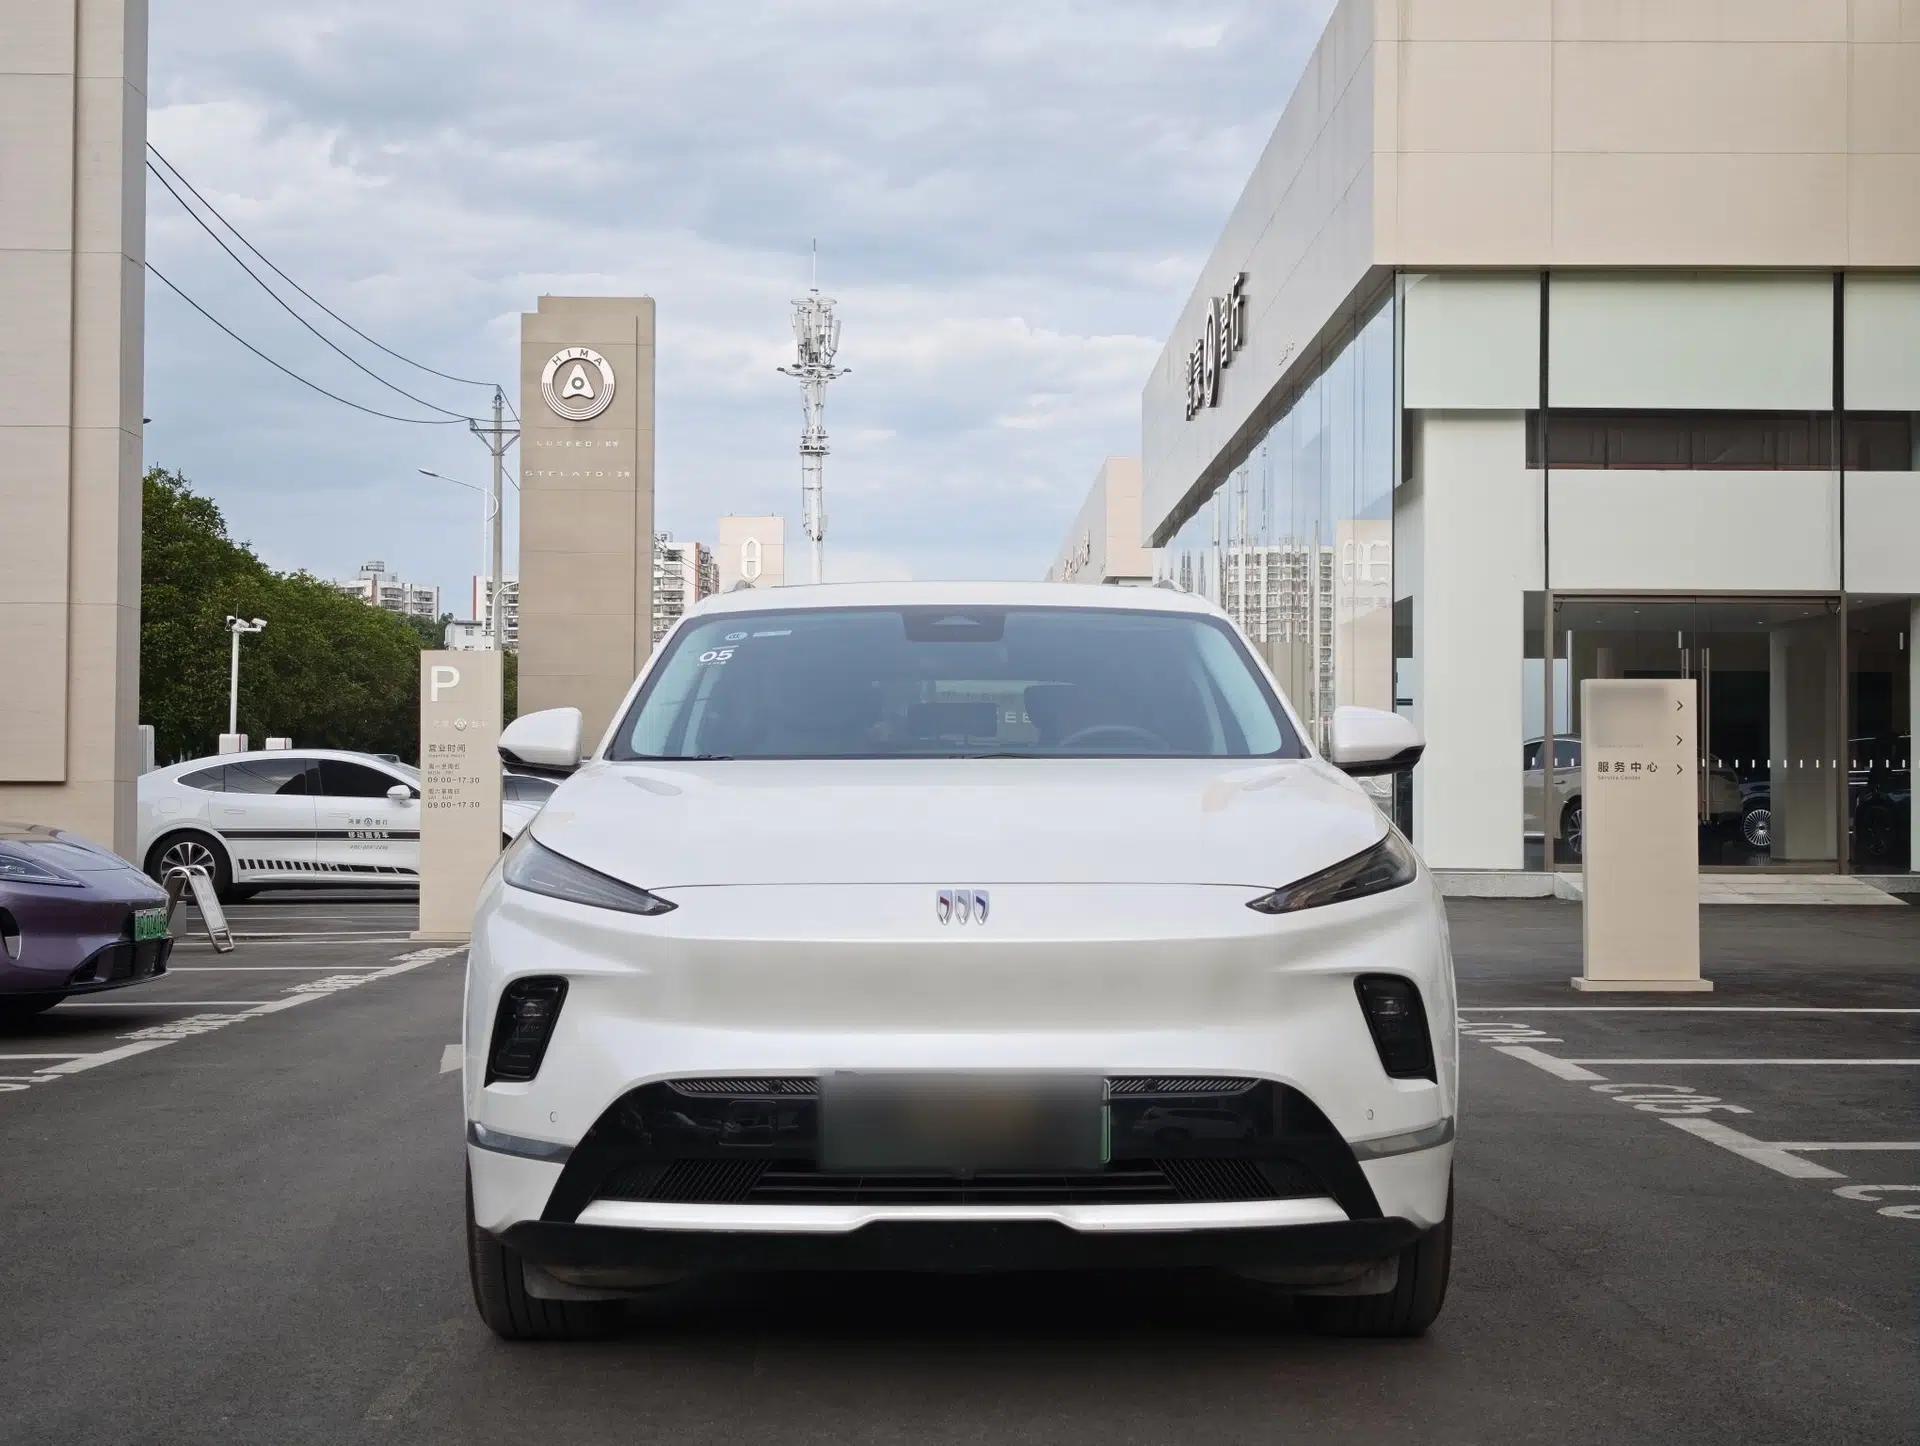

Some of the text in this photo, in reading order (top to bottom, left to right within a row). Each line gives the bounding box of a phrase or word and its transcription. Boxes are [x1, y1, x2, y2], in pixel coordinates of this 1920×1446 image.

[552, 348, 603, 367] HIMA
[699, 649, 735, 663] 05
[431, 665, 460, 702] P
[1597, 761, 1658, 773] 服务中心
[1589, 1083, 1754, 1114] C05
